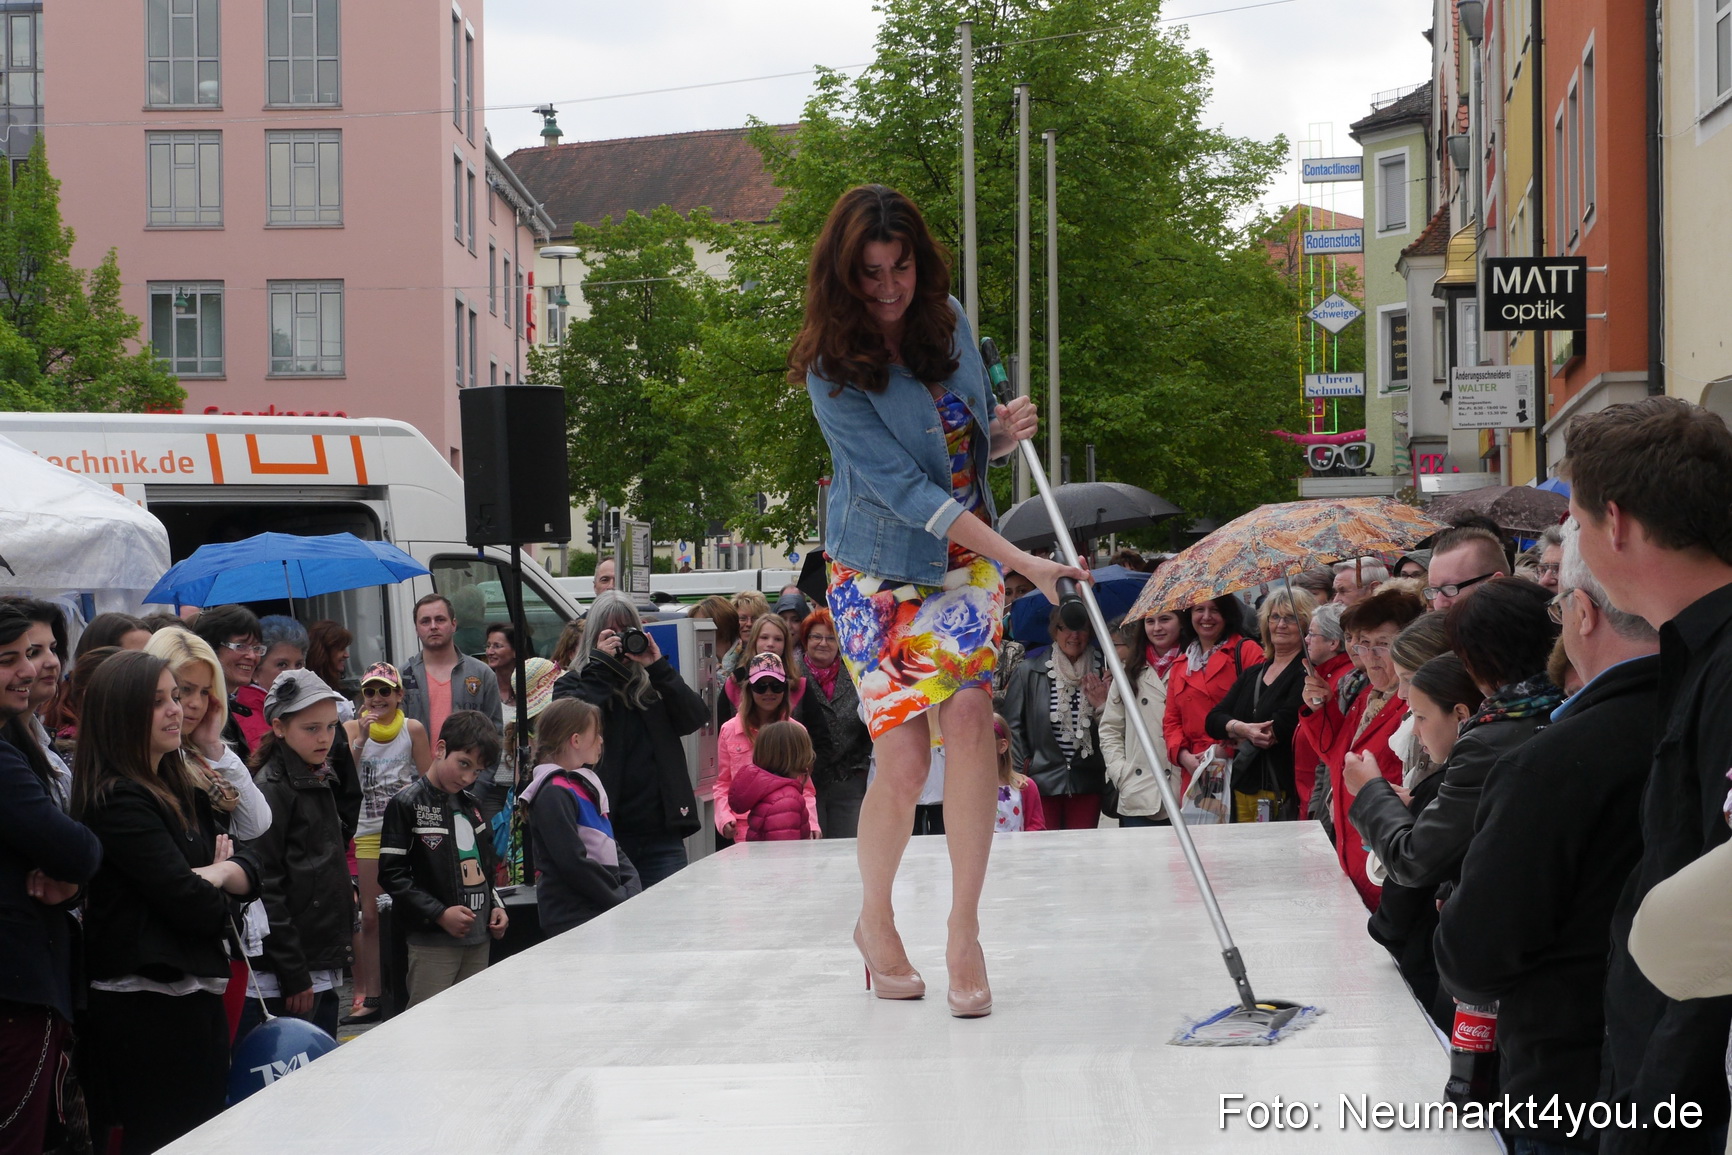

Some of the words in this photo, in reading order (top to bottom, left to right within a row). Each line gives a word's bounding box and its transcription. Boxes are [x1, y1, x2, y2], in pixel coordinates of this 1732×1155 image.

[1304, 163, 1360, 176] Contactlinsen
[1305, 233, 1361, 249] Rodenstock
[1492, 265, 1580, 294] MATT
[1324, 300, 1345, 310] Optik
[1312, 308, 1358, 320] Schweiger
[1501, 299, 1566, 324] optik
[1317, 374, 1353, 385] Uhren
[1455, 370, 1512, 382] Änderungsschneiderei
[1308, 384, 1362, 396] Schmuck
[1457, 383, 1497, 392] WALTER
[32, 450, 195, 474] echnik.de
[431, 806, 442, 814] OF
[470, 892, 485, 911] UP
[1457, 1021, 1492, 1038] Coca-Cola
